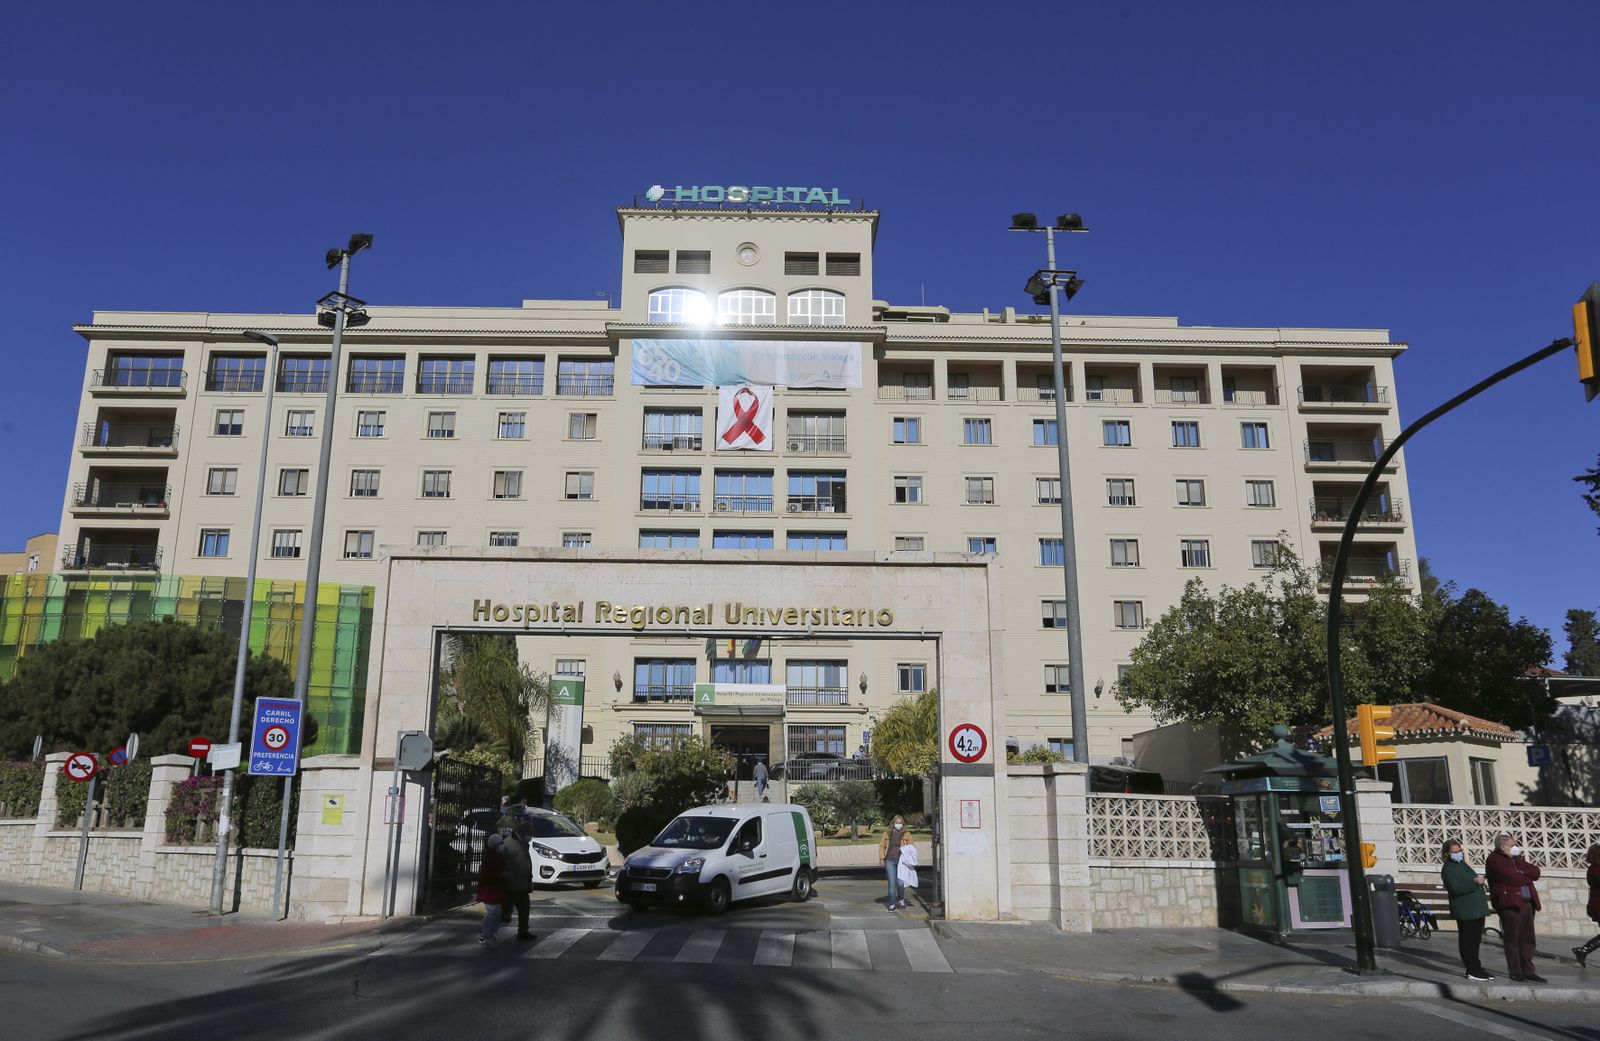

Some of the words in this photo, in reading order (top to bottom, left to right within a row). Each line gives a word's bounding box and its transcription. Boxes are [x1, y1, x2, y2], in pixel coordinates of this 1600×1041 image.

[675, 185, 850, 204] HOSPITAL
[472, 599, 584, 630] Hospital
[595, 601, 713, 632] Regional
[724, 602, 894, 627] Universitario
[268, 733, 284, 743] 30
